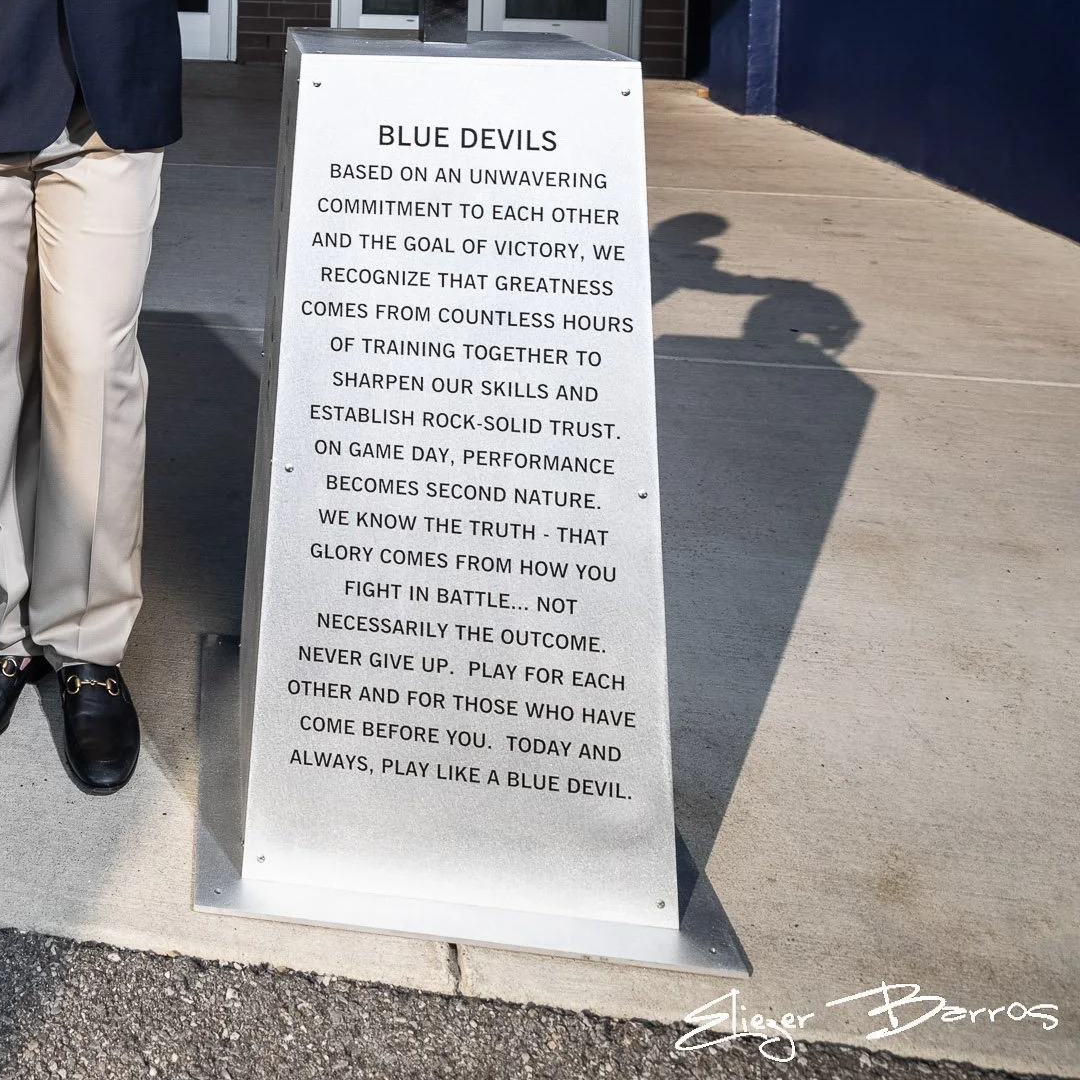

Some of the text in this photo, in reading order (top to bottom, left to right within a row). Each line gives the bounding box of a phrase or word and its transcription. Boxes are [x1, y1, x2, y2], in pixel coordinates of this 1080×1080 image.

[379, 124, 557, 152] BLUE DEVILS
[330, 163, 607, 190] BASED ON AN UNWAVERING
[317, 197, 620, 226] COMMITMENT TO EACH OTHER
[311, 231, 626, 262] AND THE GOAL OF VICTORY, WE
[321, 266, 614, 297] RECOGNIZE THAT GREATNESS
[301, 300, 634, 334] COMES FROM COUNTLESS HOURS
[330, 336, 602, 367] OF TRAINING TOGETHER TO
[332, 371, 599, 403] SHARPEN OUR SKILLS AND
[310, 404, 621, 440] ESTABLISH ROCK-SOLID TRUST.
[314, 439, 615, 476] ON GAME DAY, PERFORMANCE
[326, 474, 601, 510] BECOMES SECOND NATURE.
[318, 508, 350, 526] WE
[356, 511, 417, 531] KNOW
[423, 516, 463, 535] THE
[468, 519, 536, 541] TRUTH
[556, 526, 609, 546] THAT
[310, 542, 616, 583] GLORY COMES FROM HOW YOU
[344, 579, 578, 615] FIGHT IN BATTLE... NOT
[317, 612, 606, 654] NECESSARILY THE OUTCOME.
[298, 645, 625, 692] NEVER GIVE UP. PLAY FOR EACH
[287, 679, 637, 729] OTHER AND FOR THOSE WHO HAVE
[299, 715, 622, 762] COME BEFORE YOU. TODAY AND
[289, 748, 632, 800] ALWAYS, PLAY LIKE A BLUE DEVIL.
